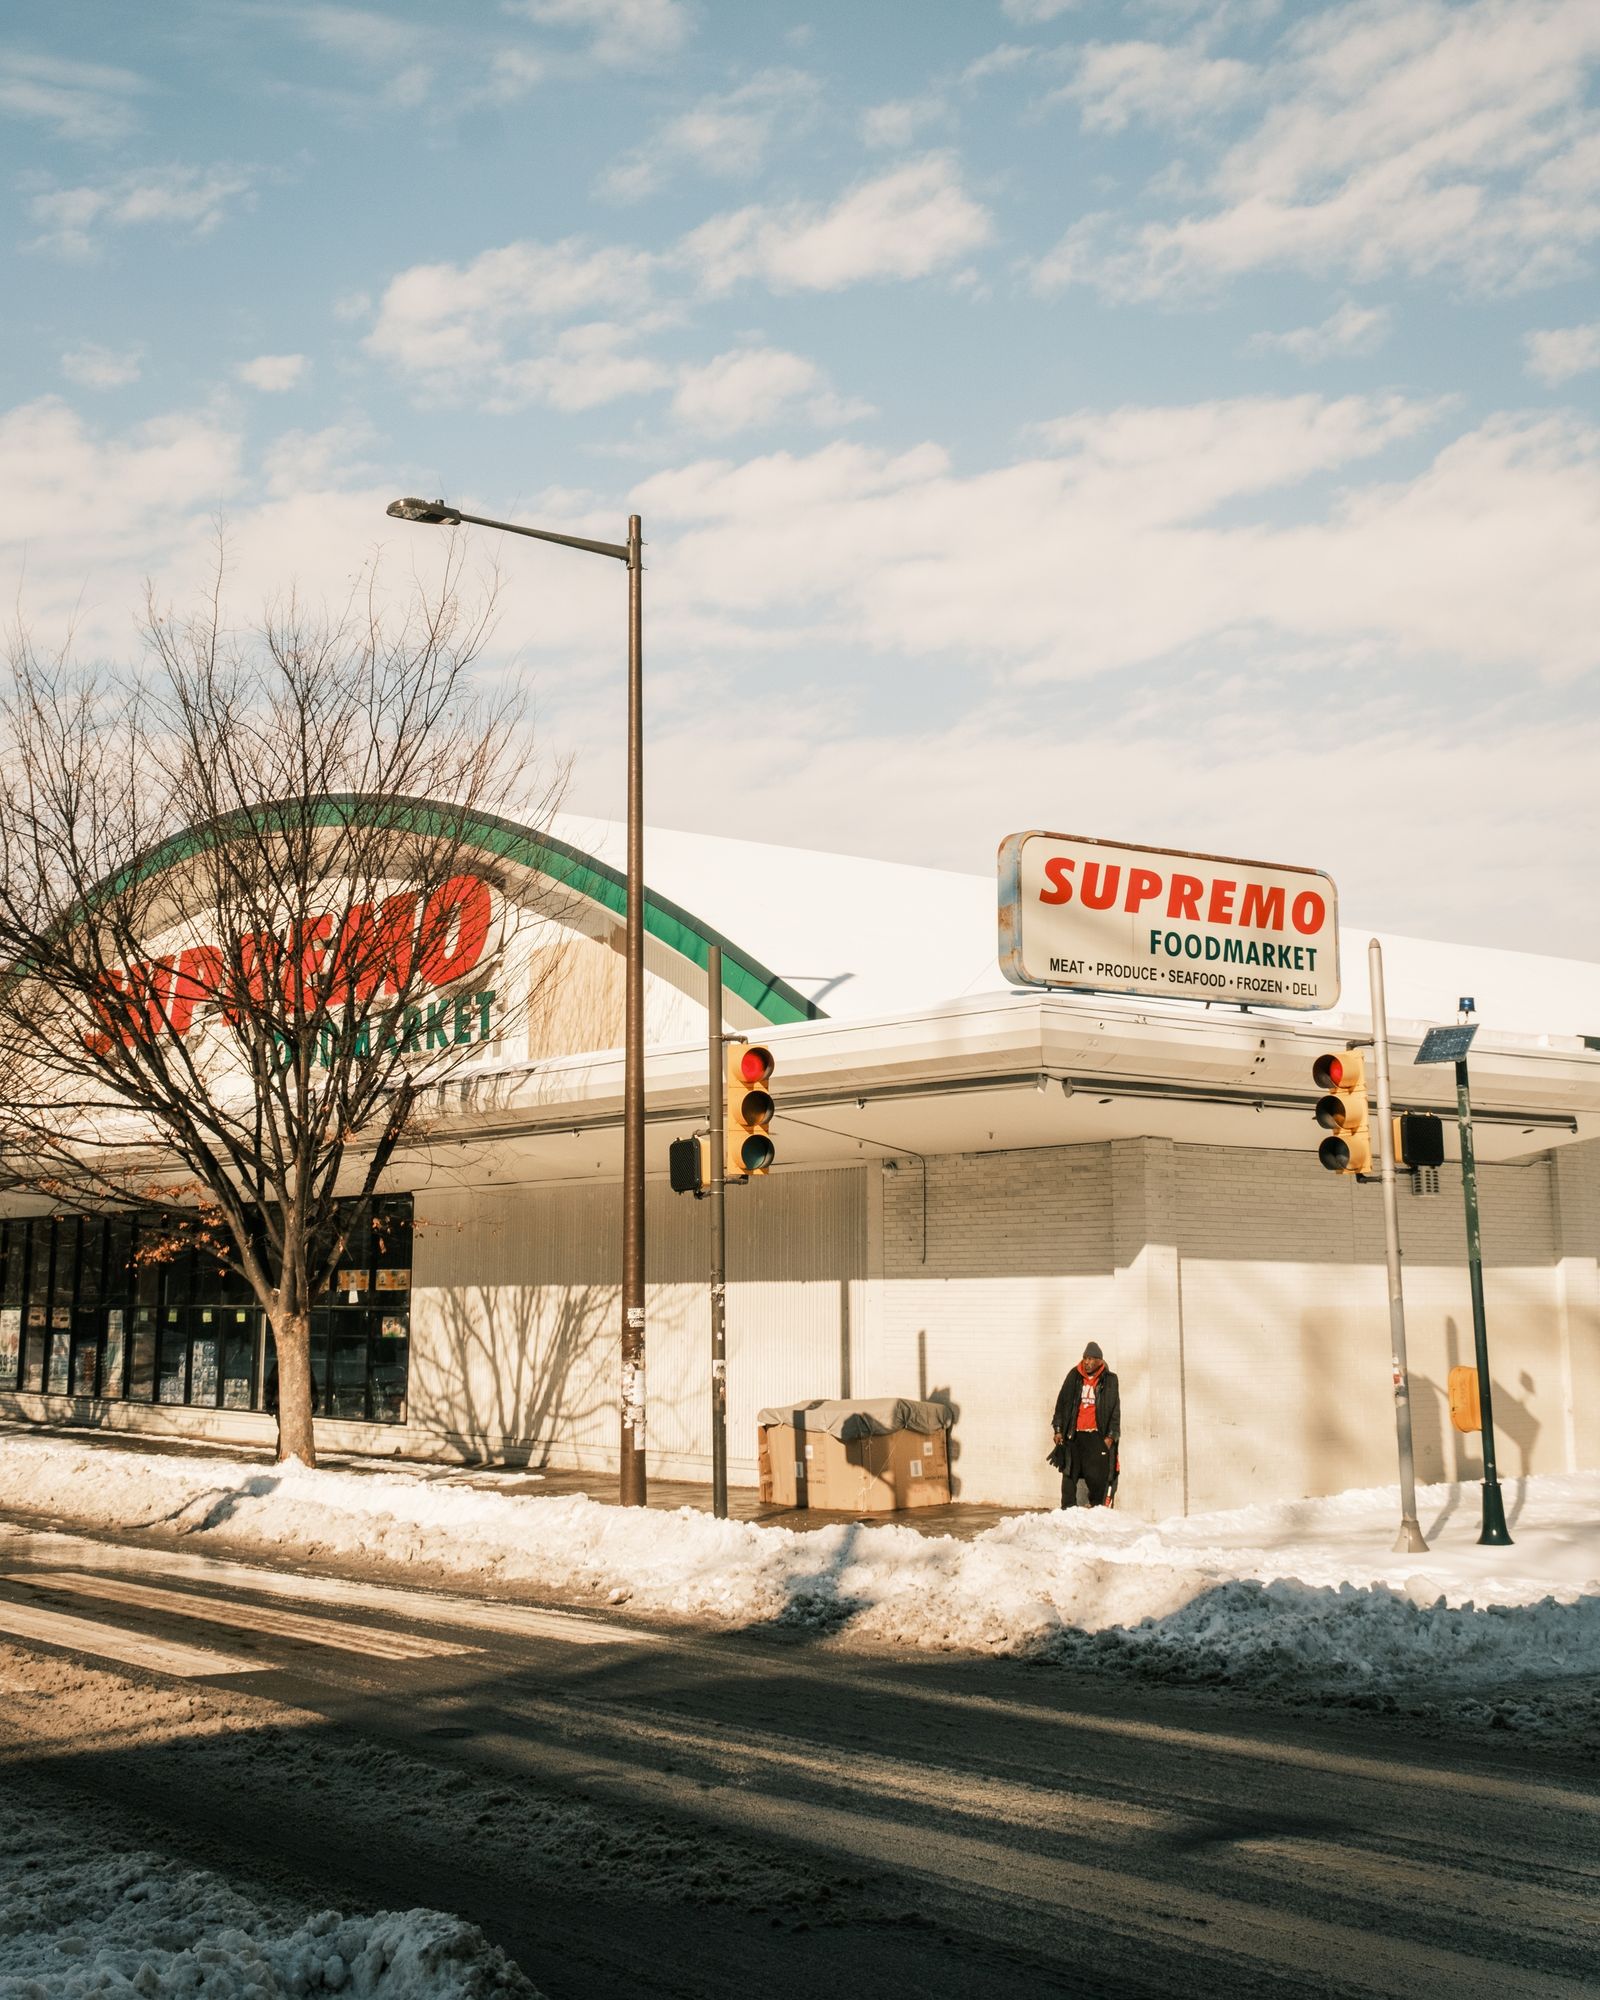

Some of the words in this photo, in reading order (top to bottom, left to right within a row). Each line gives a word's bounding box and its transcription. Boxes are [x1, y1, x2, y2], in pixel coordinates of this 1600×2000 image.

[1039, 858, 1325, 934] SUPREMO
[1150, 930, 1317, 972] FOODMARKET
[1049, 957, 1084, 975] MEAT
[1096, 962, 1158, 981] PRODUCE
[1168, 969, 1226, 987] SEAFOOD
[1236, 976, 1282, 994] FROZEN
[1293, 982, 1318, 997] DELI
